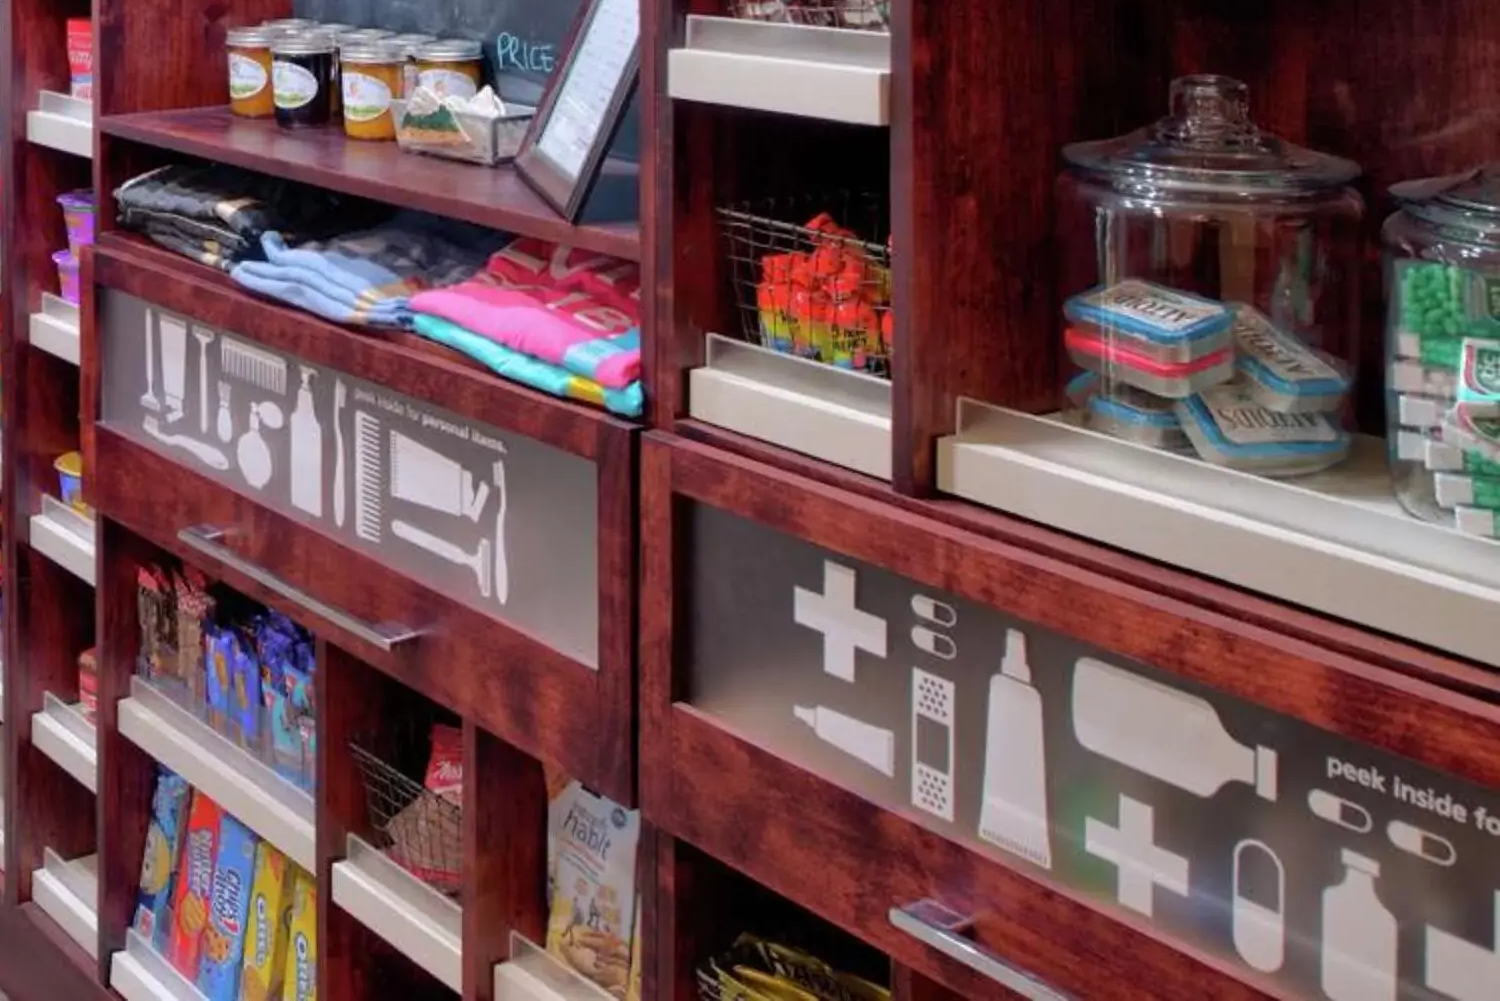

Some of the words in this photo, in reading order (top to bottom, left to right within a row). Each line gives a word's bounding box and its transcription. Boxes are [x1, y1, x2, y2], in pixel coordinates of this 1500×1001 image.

[496, 31, 554, 72] PRICE
[1326, 755, 1387, 794] peek
[1393, 775, 1468, 824] inside
